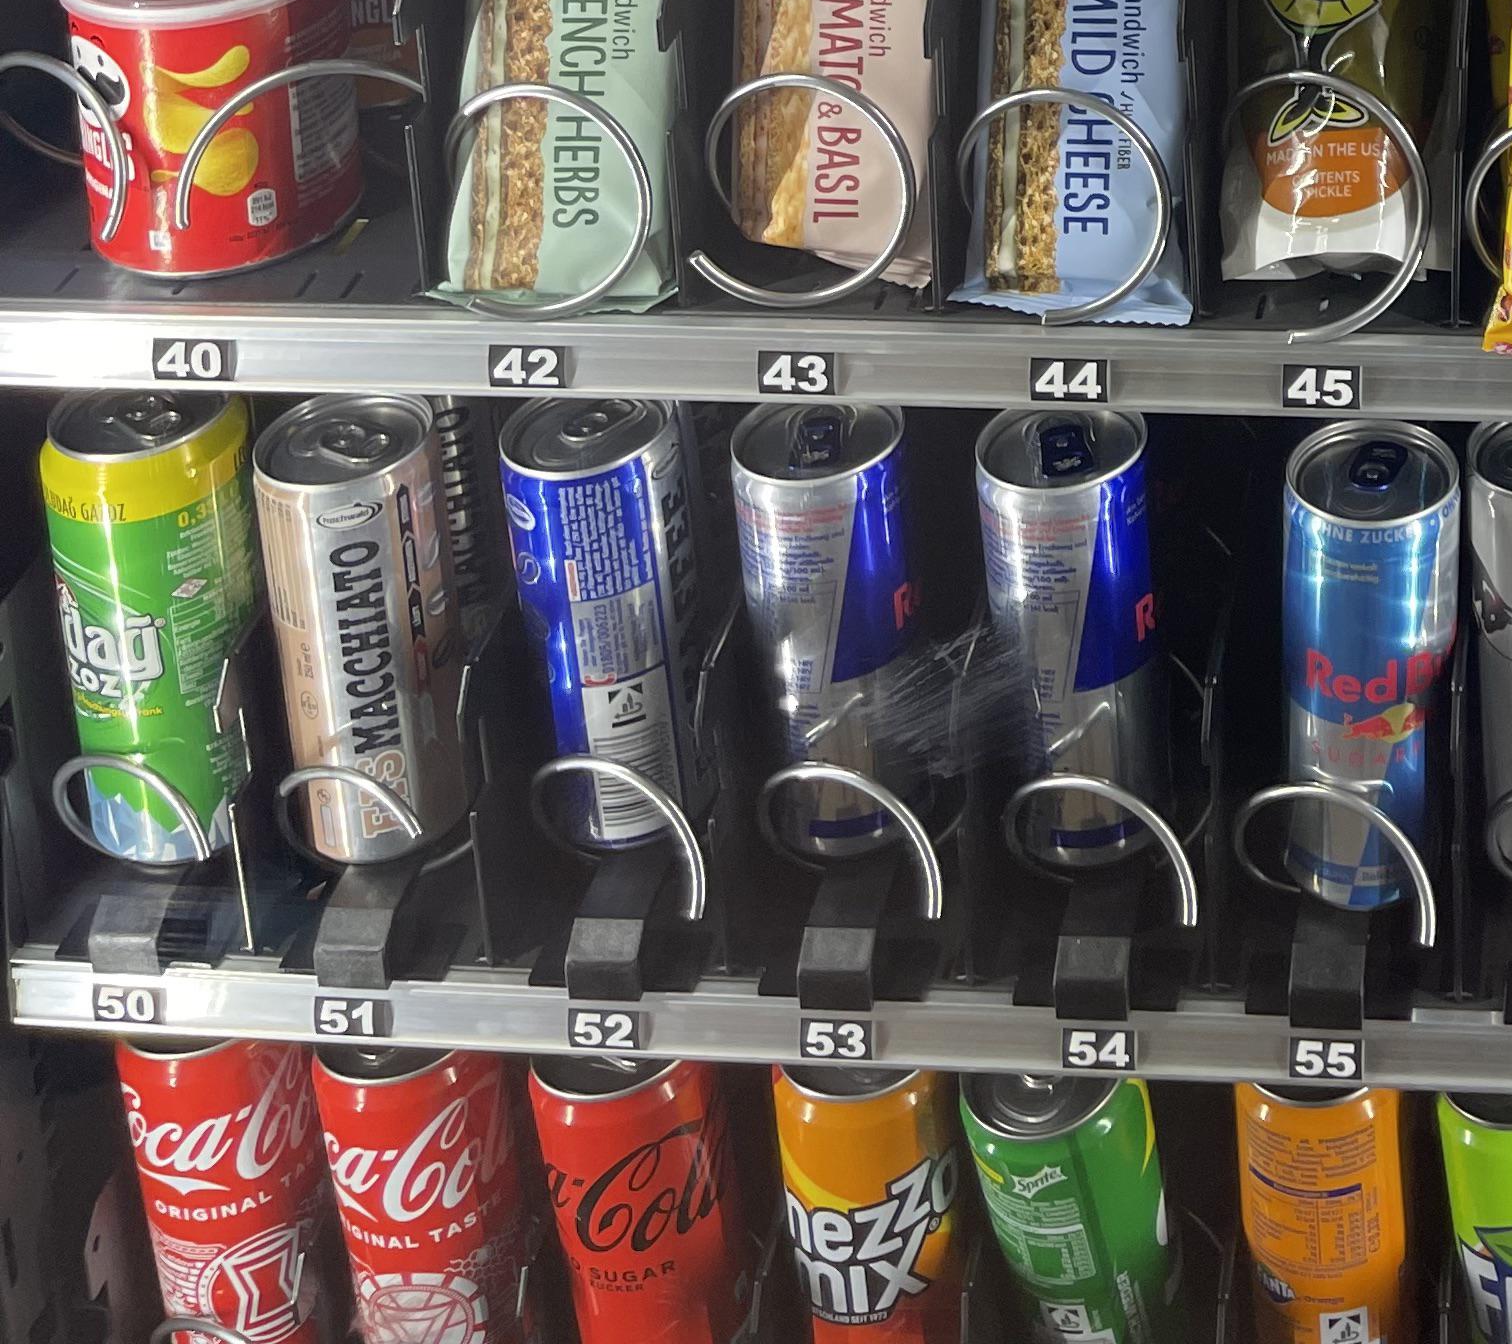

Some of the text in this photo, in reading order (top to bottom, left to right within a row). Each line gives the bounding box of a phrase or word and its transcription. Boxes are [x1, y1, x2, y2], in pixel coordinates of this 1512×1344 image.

[1327, 142, 1357, 156] THE
[551, 113, 604, 229] HERBS
[812, 125, 863, 224] BASIL
[156, 341, 222, 379] 40
[492, 347, 559, 386] 42
[762, 354, 828, 393] 43
[1034, 361, 1102, 399] 44
[1287, 367, 1354, 407] 45
[329, 539, 402, 756] MACCHIATO
[1305, 647, 1397, 703] Red
[98, 987, 152, 1022] 50
[319, 999, 374, 1035] 51
[573, 1012, 634, 1048] 52
[805, 1021, 866, 1058] 53
[1067, 1031, 1130, 1067] 54
[1294, 1040, 1356, 1078] 55
[1015, 1168, 1066, 1196] Sprite
[154, 1191, 273, 1222] ORIGINAL
[588, 1260, 676, 1283] SUGAR
